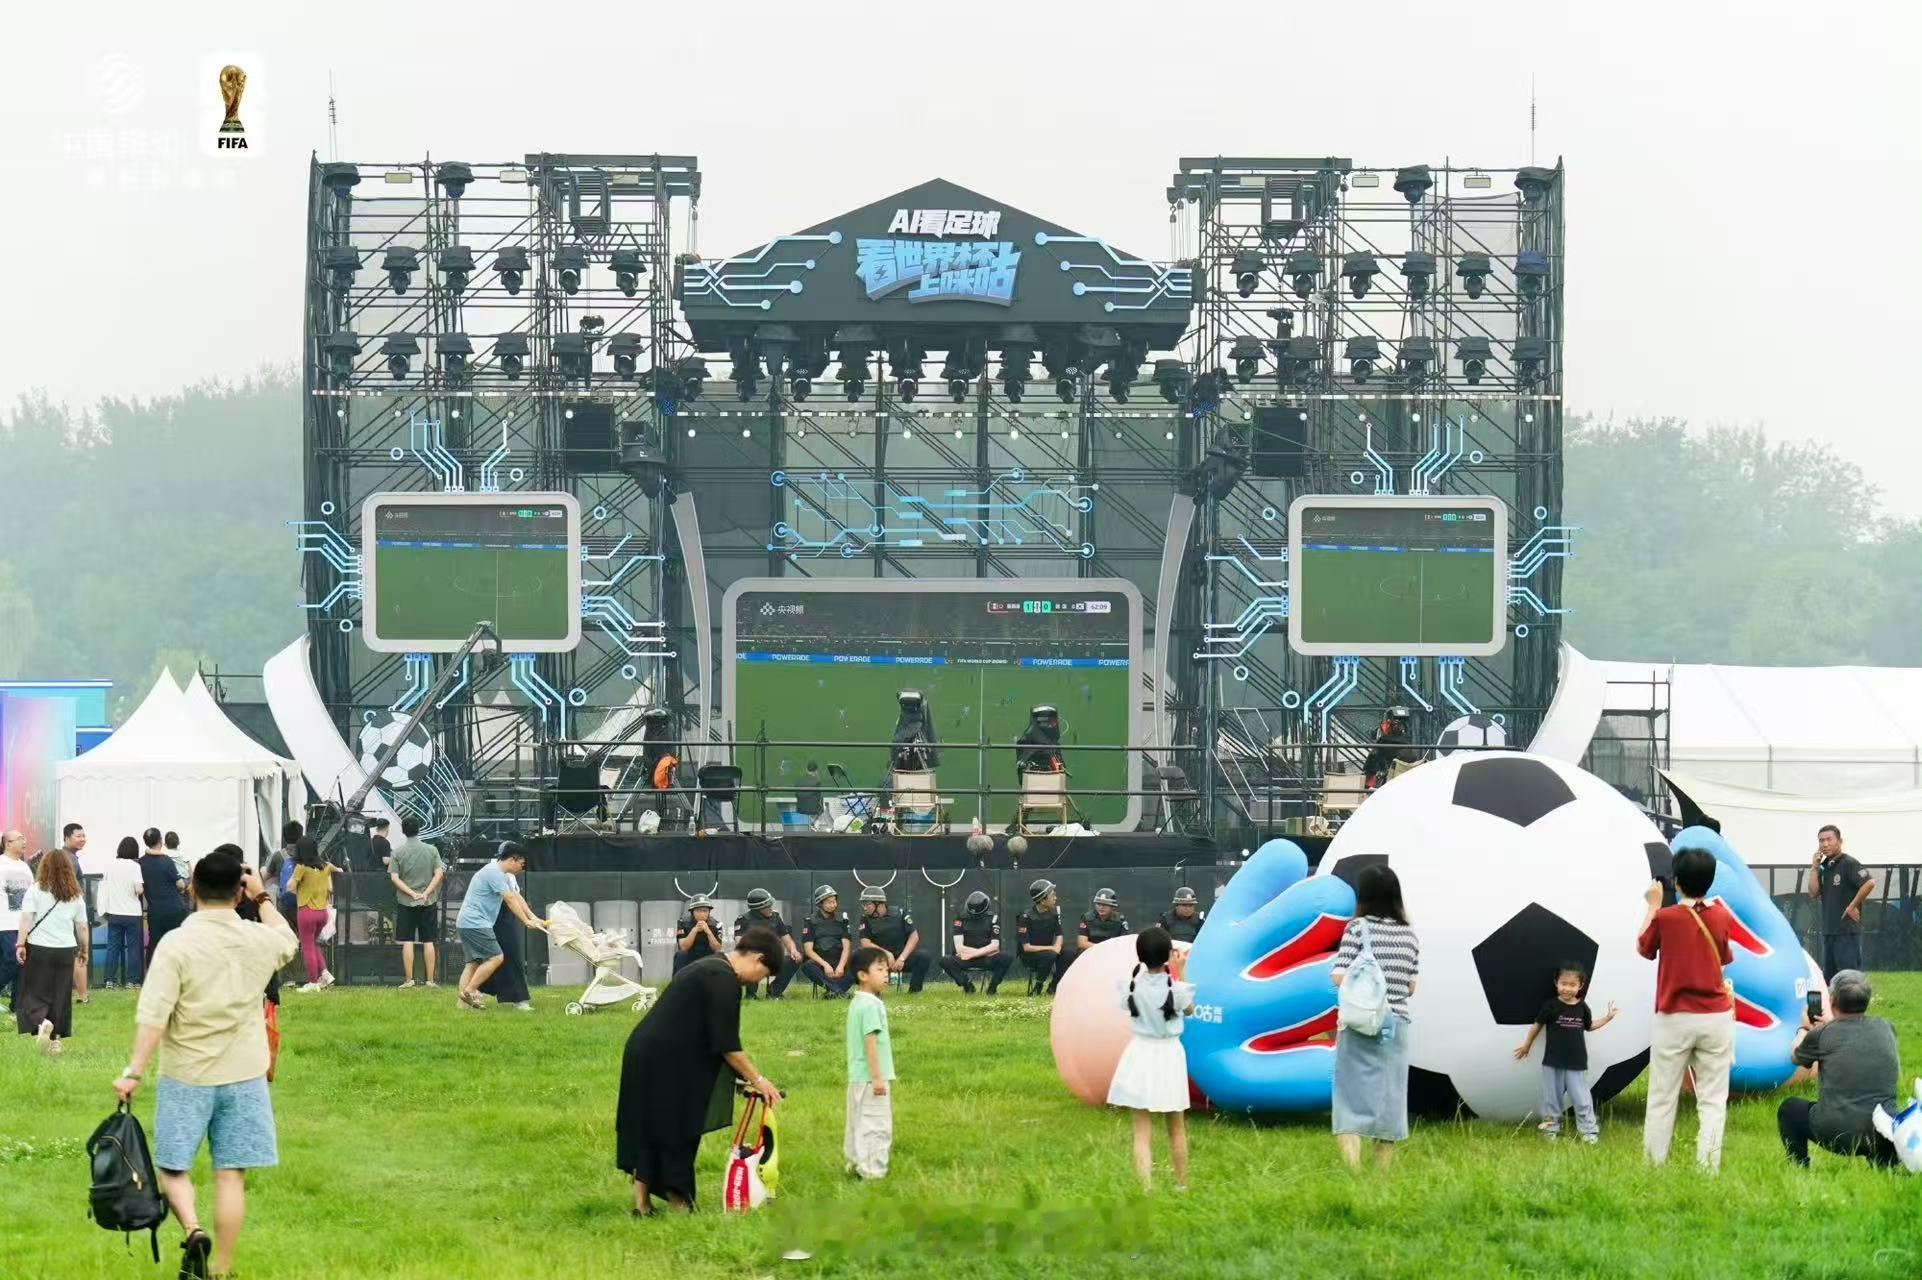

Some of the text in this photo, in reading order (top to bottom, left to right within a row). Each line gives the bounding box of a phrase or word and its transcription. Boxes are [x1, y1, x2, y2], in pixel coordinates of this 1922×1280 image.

[888, 208, 1002, 239] AI看足球
[856, 239, 997, 297] 看世界杯
[772, 653, 811, 662] POWERADE
[833, 655, 871, 663] POWERADE
[895, 656, 933, 664] POWERADE
